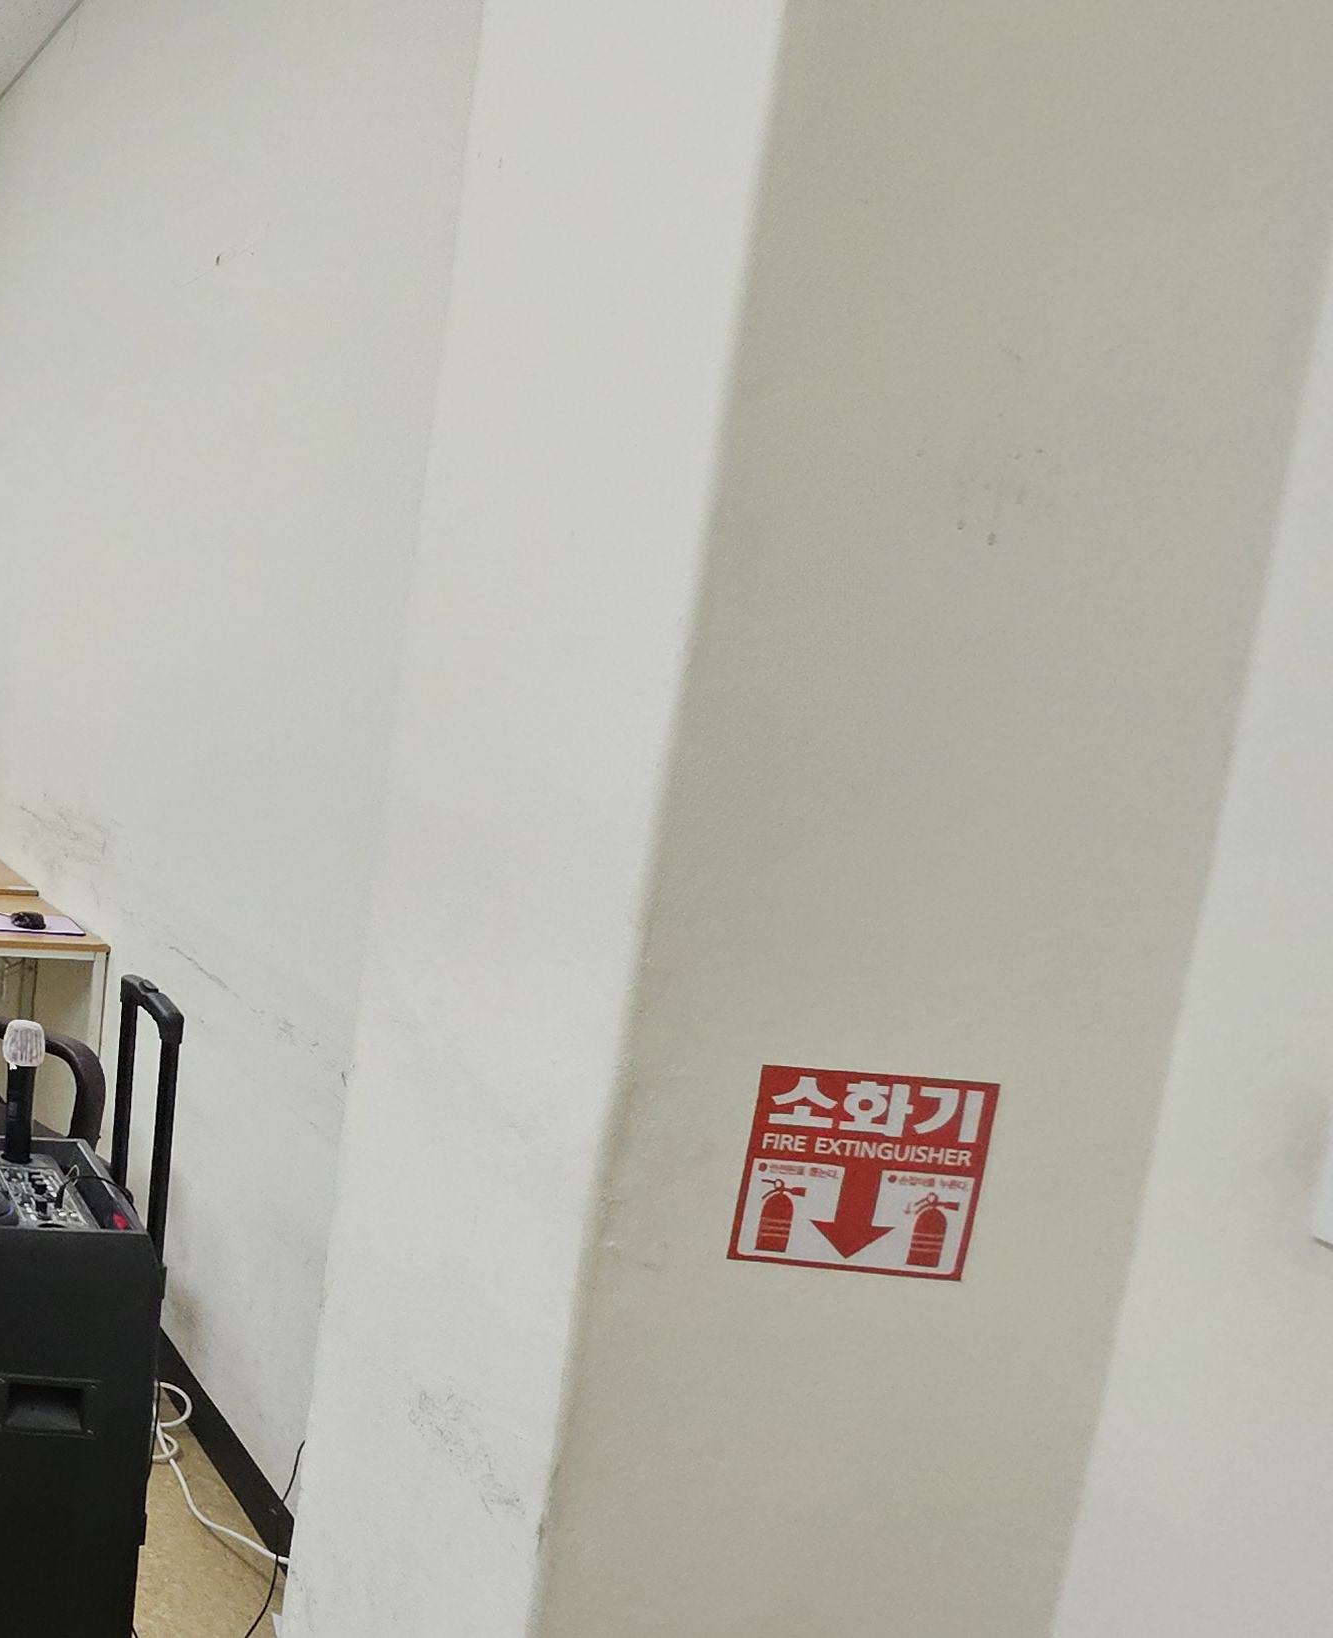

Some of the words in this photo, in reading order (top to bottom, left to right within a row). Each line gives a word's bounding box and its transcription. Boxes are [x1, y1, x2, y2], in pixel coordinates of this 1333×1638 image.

[768, 1075, 985, 1144] 소화기
[761, 1132, 808, 1153] FIRE
[814, 1136, 972, 1167] EXTINGUISHER
